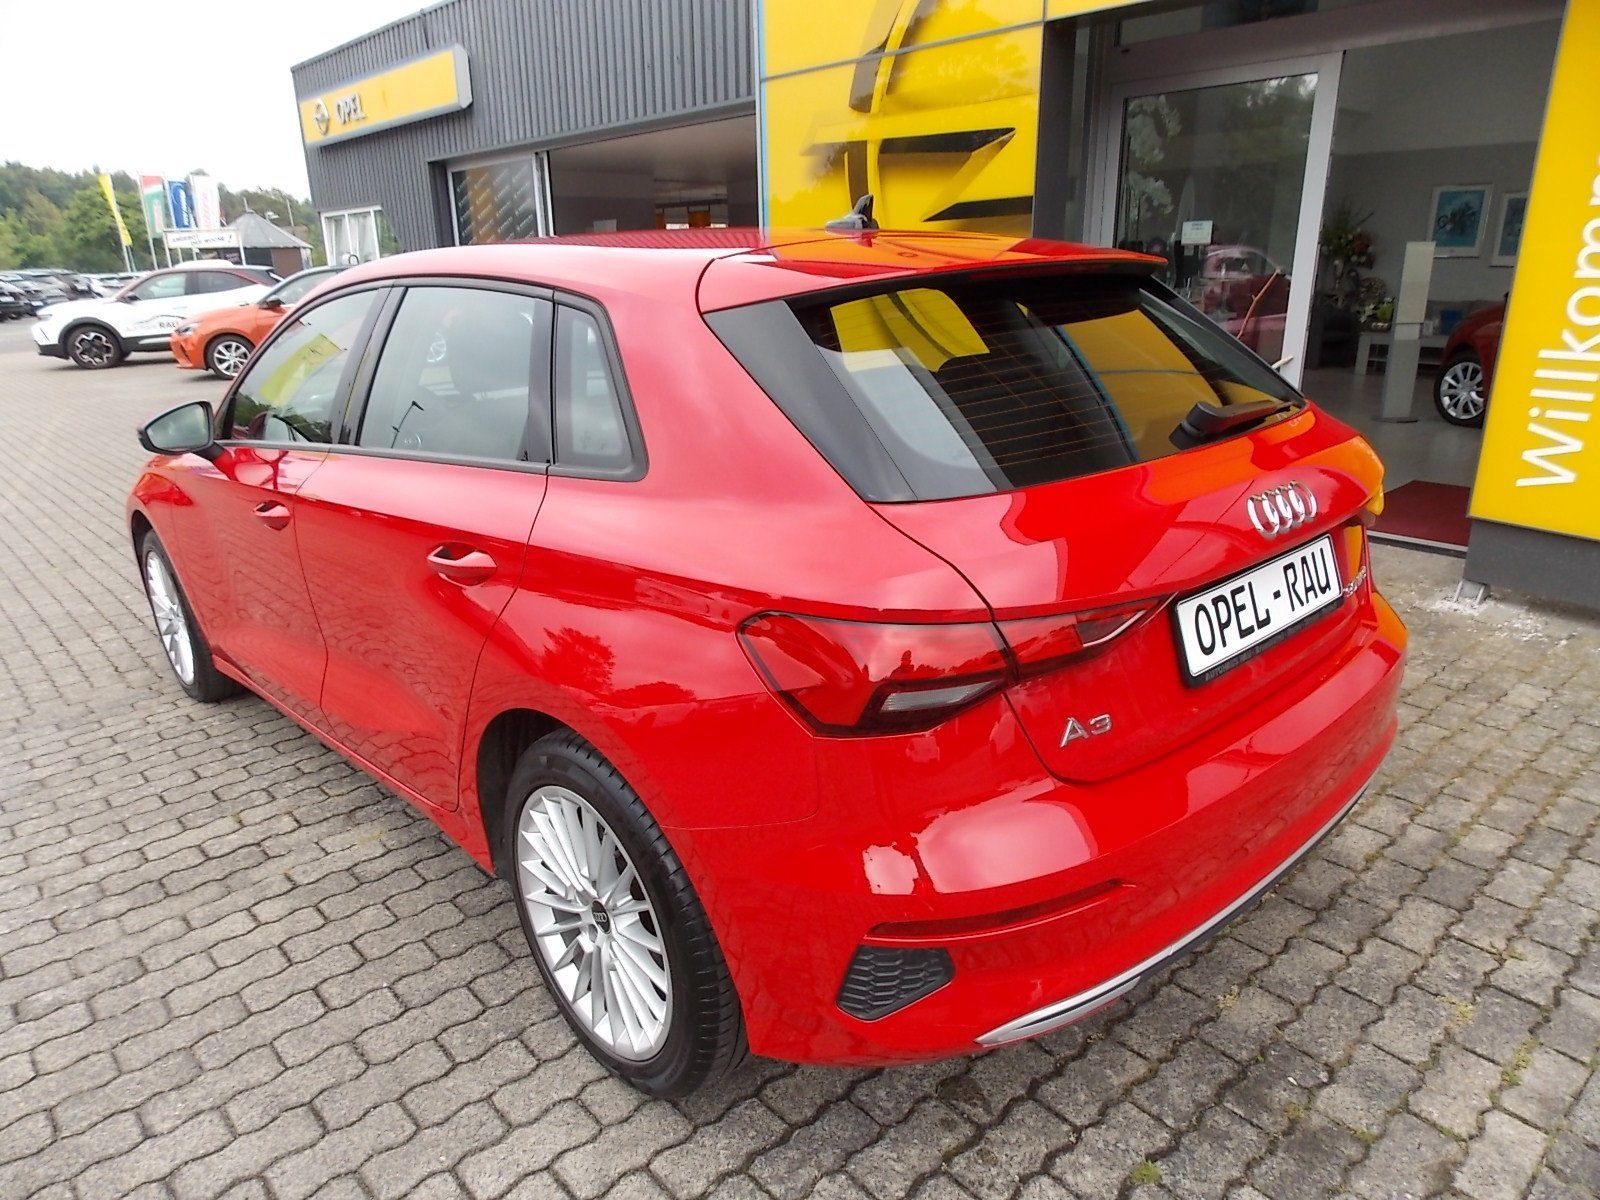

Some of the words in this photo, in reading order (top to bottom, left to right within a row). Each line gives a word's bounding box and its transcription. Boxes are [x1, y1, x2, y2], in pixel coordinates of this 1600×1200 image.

[335, 93, 367, 125] OPEL
[1194, 581, 1272, 656] OPEL
[1282, 547, 1332, 612] RAU
[1060, 713, 1112, 748] A3
